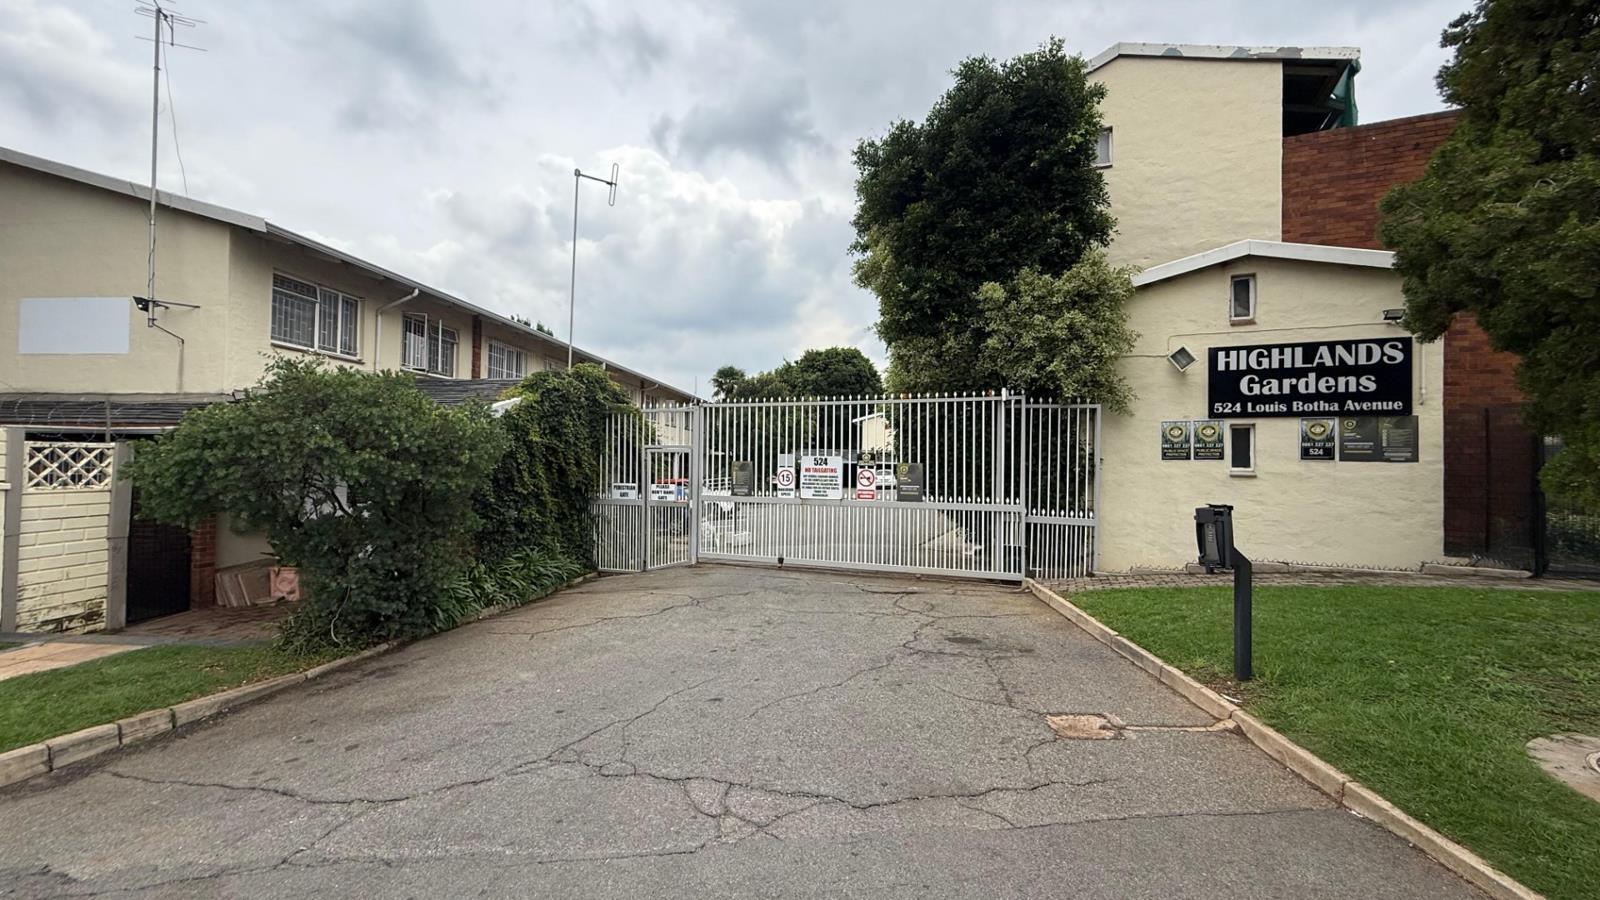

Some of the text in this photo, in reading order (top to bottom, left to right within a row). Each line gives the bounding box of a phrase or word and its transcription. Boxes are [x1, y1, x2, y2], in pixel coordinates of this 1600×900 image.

[1217, 341, 1405, 372] HIGHLANDS
[1239, 372, 1377, 396] Gardens
[1213, 399, 1403, 413] 524 Louis Botha Avenue
[813, 457, 828, 466] 524
[781, 473, 791, 482] 15
